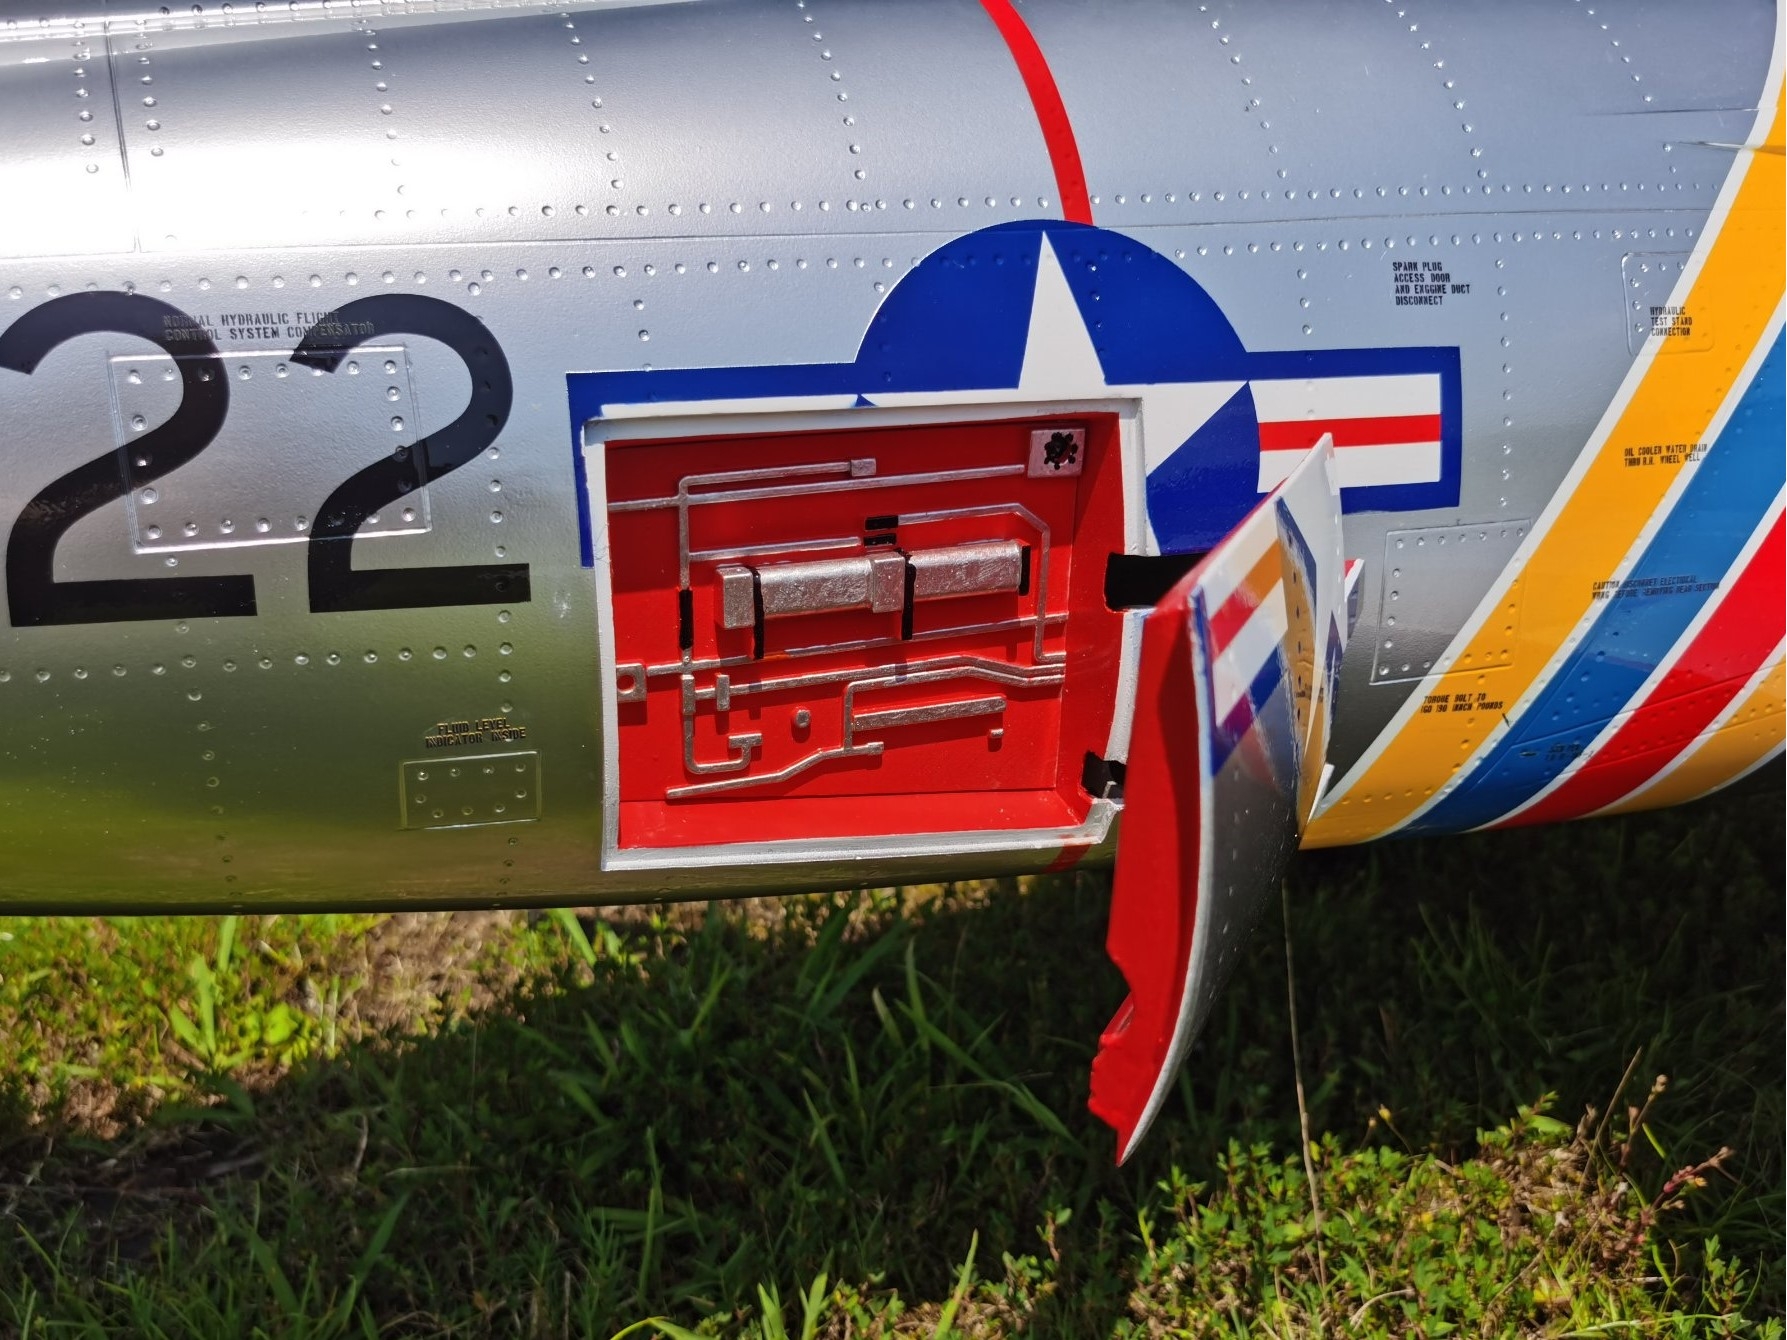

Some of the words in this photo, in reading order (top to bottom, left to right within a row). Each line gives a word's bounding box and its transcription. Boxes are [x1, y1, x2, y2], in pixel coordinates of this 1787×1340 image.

[1392, 261, 1418, 272] SPARK
[1422, 261, 1443, 272] PLUG
[1394, 273, 1425, 283] ACCESS
[1430, 273, 1451, 283] DOOR
[1395, 284, 1410, 294] AND
[1451, 284, 1470, 294] DUCT
[1395, 295, 1443, 306] DISCONNECT
[1650, 306, 1686, 315] HYDRAULIC
[164, 314, 214, 328] NORMAL
[221, 312, 290, 327] HYDRAULIC
[296, 311, 339, 325] FLIGHT
[1651, 316, 1667, 326] TEST
[1672, 316, 1692, 326] STAND
[165, 327, 222, 342] CONTROL
[230, 326, 280, 340] SYSTEM
[287, 321, 375, 338] COMPENSATOR
[1651, 327, 1691, 336] CONNECTION
[1624, 448, 1634, 457] OIL
[1638, 445, 1662, 456] COOLER
[1665, 444, 1687, 454] WATER
[1690, 443, 1708, 453] DRAIN
[1624, 457, 1641, 467] THRU
[1660, 454, 1680, 464] WHEEL
[1684, 453, 1700, 462] WELL
[1592, 580, 1620, 591] CAUTION
[1424, 694, 1450, 704] TORQUE
[1454, 693, 1473, 703] BOLT
[1476, 692, 1486, 702] TO
[1476, 701, 1503, 711] POUNDS
[437, 720, 470, 735] FLUID
[475, 717, 511, 732] LEVEL
[425, 731, 484, 749] INDICATOR
[490, 726, 527, 742] INSIDE
